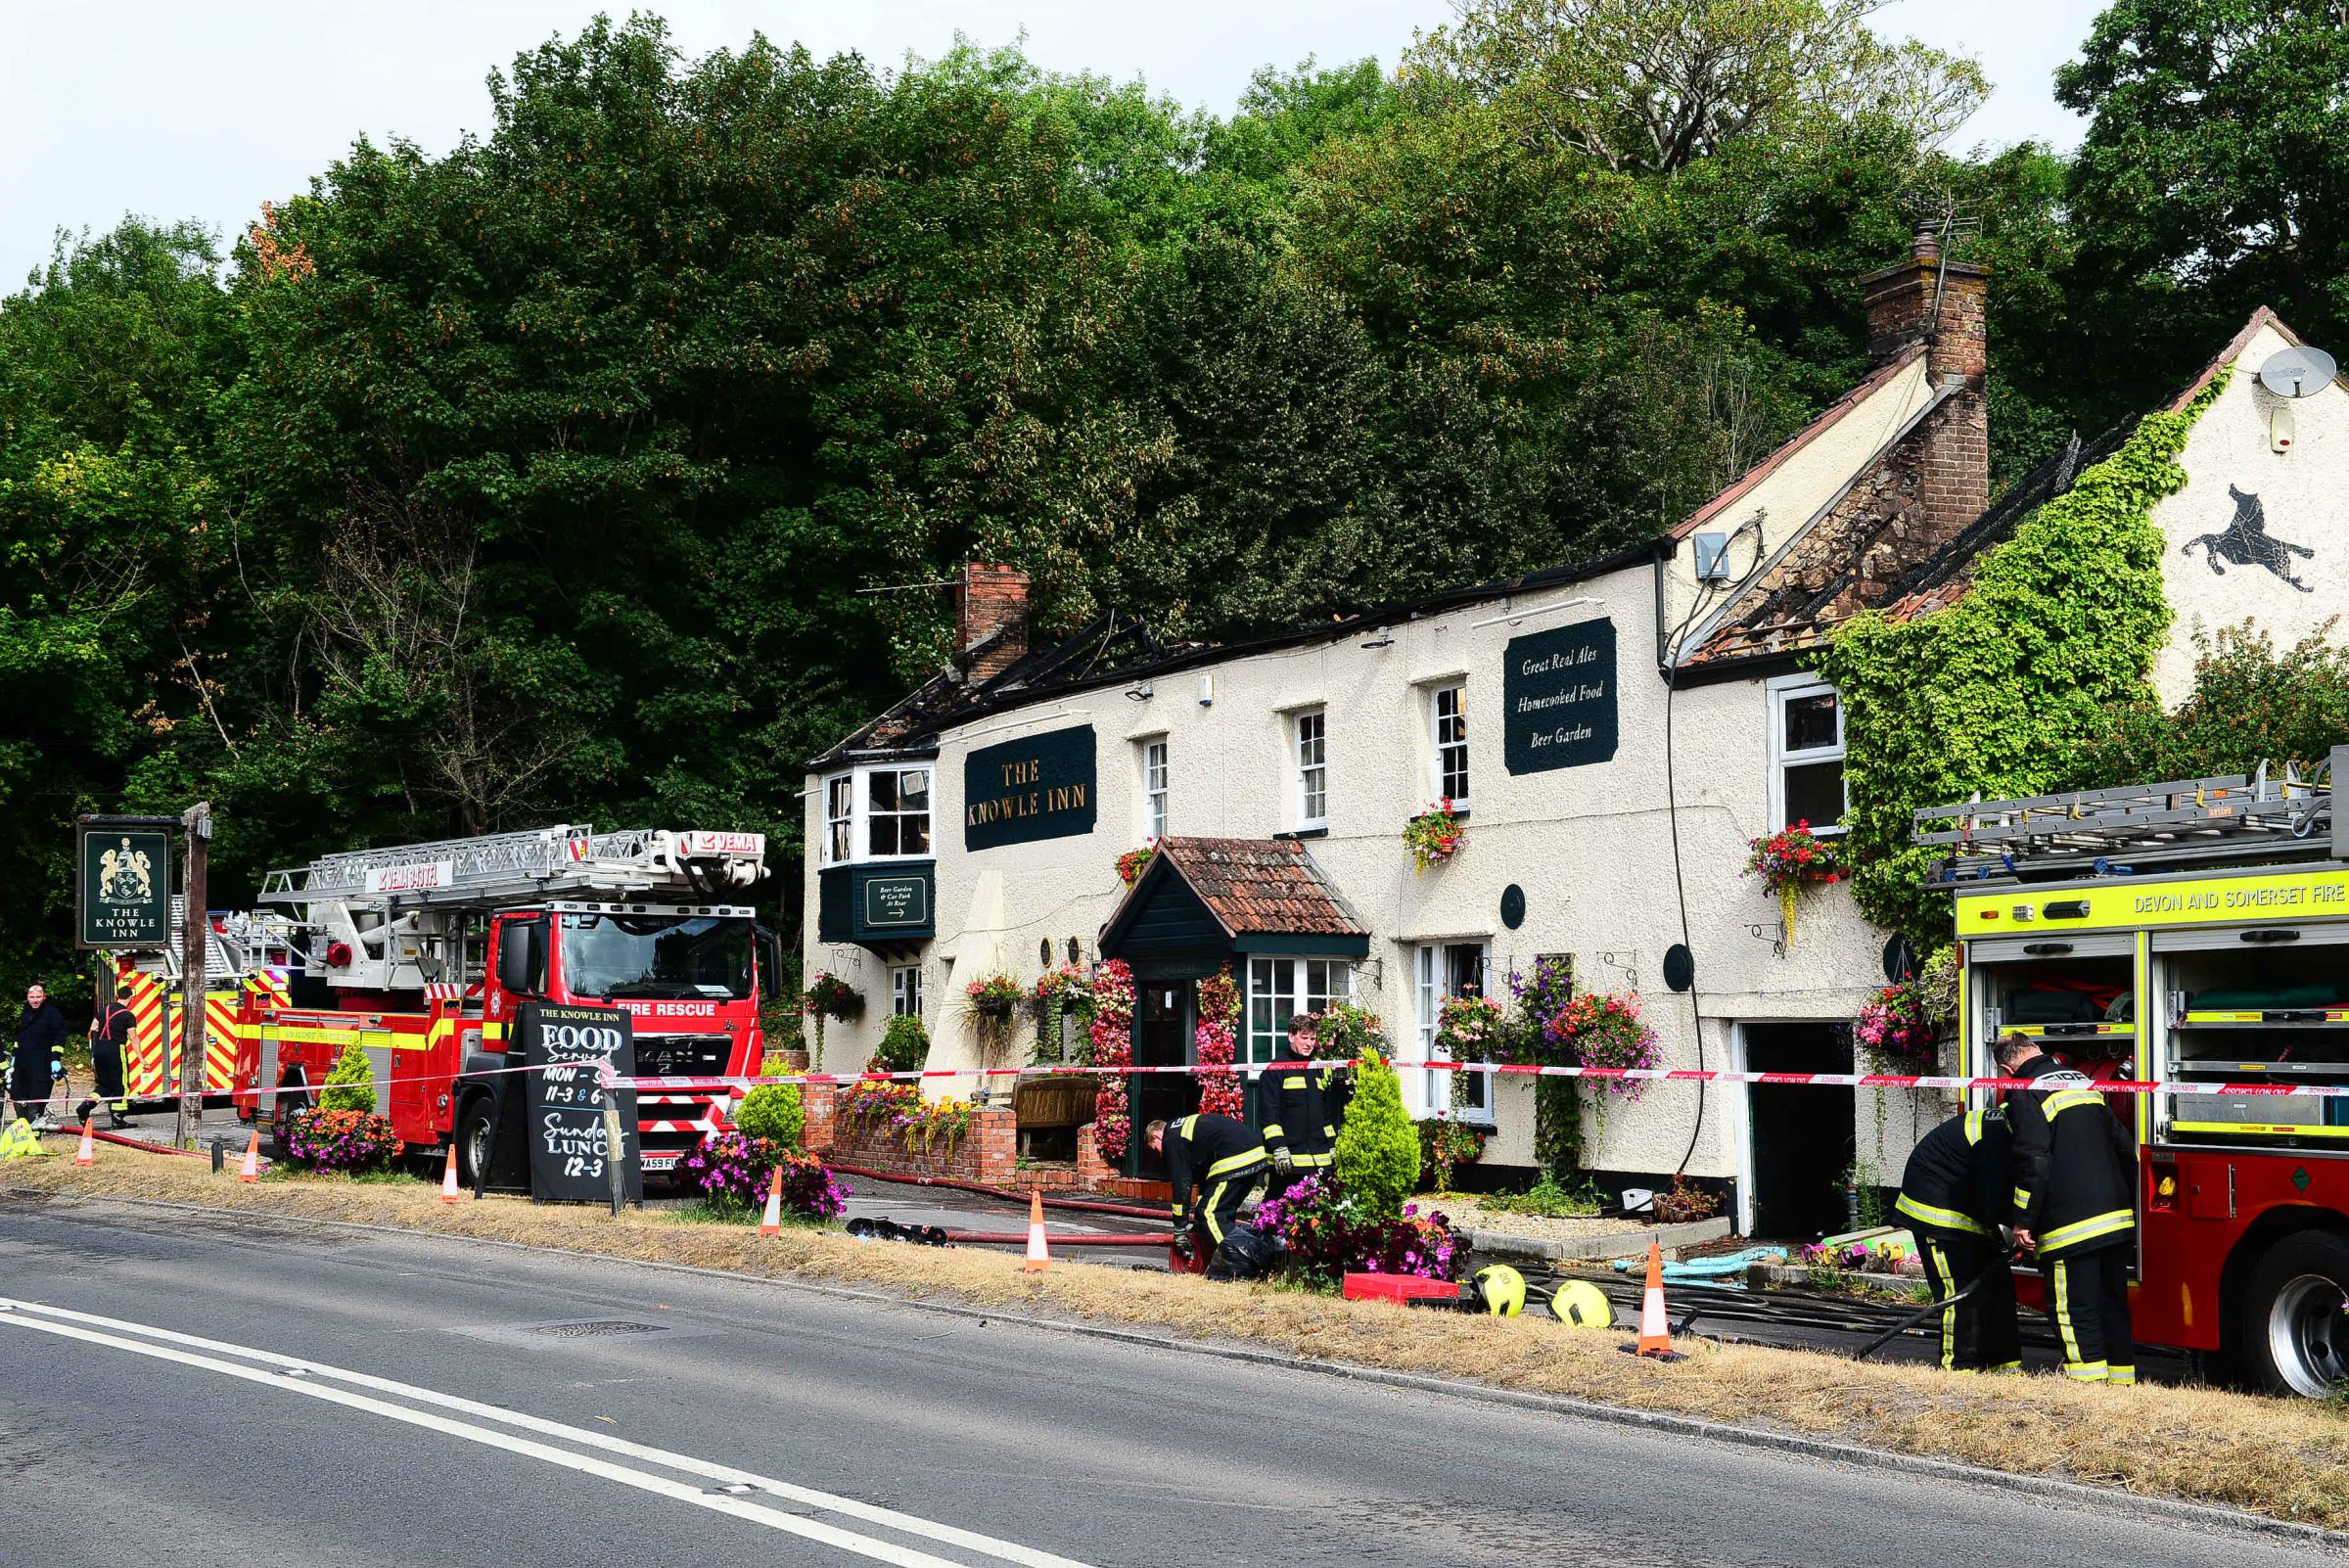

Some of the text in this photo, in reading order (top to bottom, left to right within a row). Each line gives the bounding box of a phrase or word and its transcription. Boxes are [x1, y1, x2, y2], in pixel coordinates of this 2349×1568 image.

[1522, 645, 1597, 676] Great Real Ales
[1517, 679, 1604, 714] Homecooked Food
[1531, 722, 1591, 749] Beer Garden
[1001, 760, 1039, 787] THE
[967, 783, 1085, 827] KNOWLE INN
[719, 834, 757, 852] VEMA
[2135, 884, 2345, 913] DEVON AND SOMERSET FIRE
[95, 918, 156, 928] KNOWLE
[112, 908, 140, 917] THE
[112, 929, 138, 938] INN
[540, 1008, 620, 1022] THE KNOWLE INN
[656, 1003, 715, 1017] RESCUE
[540, 1024, 622, 1051] FOOD
[548, 1041, 613, 1063] Served
[637, 1050, 693, 1063] MAN
[542, 1067, 577, 1083] MON
[545, 1084, 575, 1102] 11-3
[577, 1088, 587, 1101] &
[543, 1112, 629, 1142] Sunda
[564, 1156, 604, 1177] 12-3
